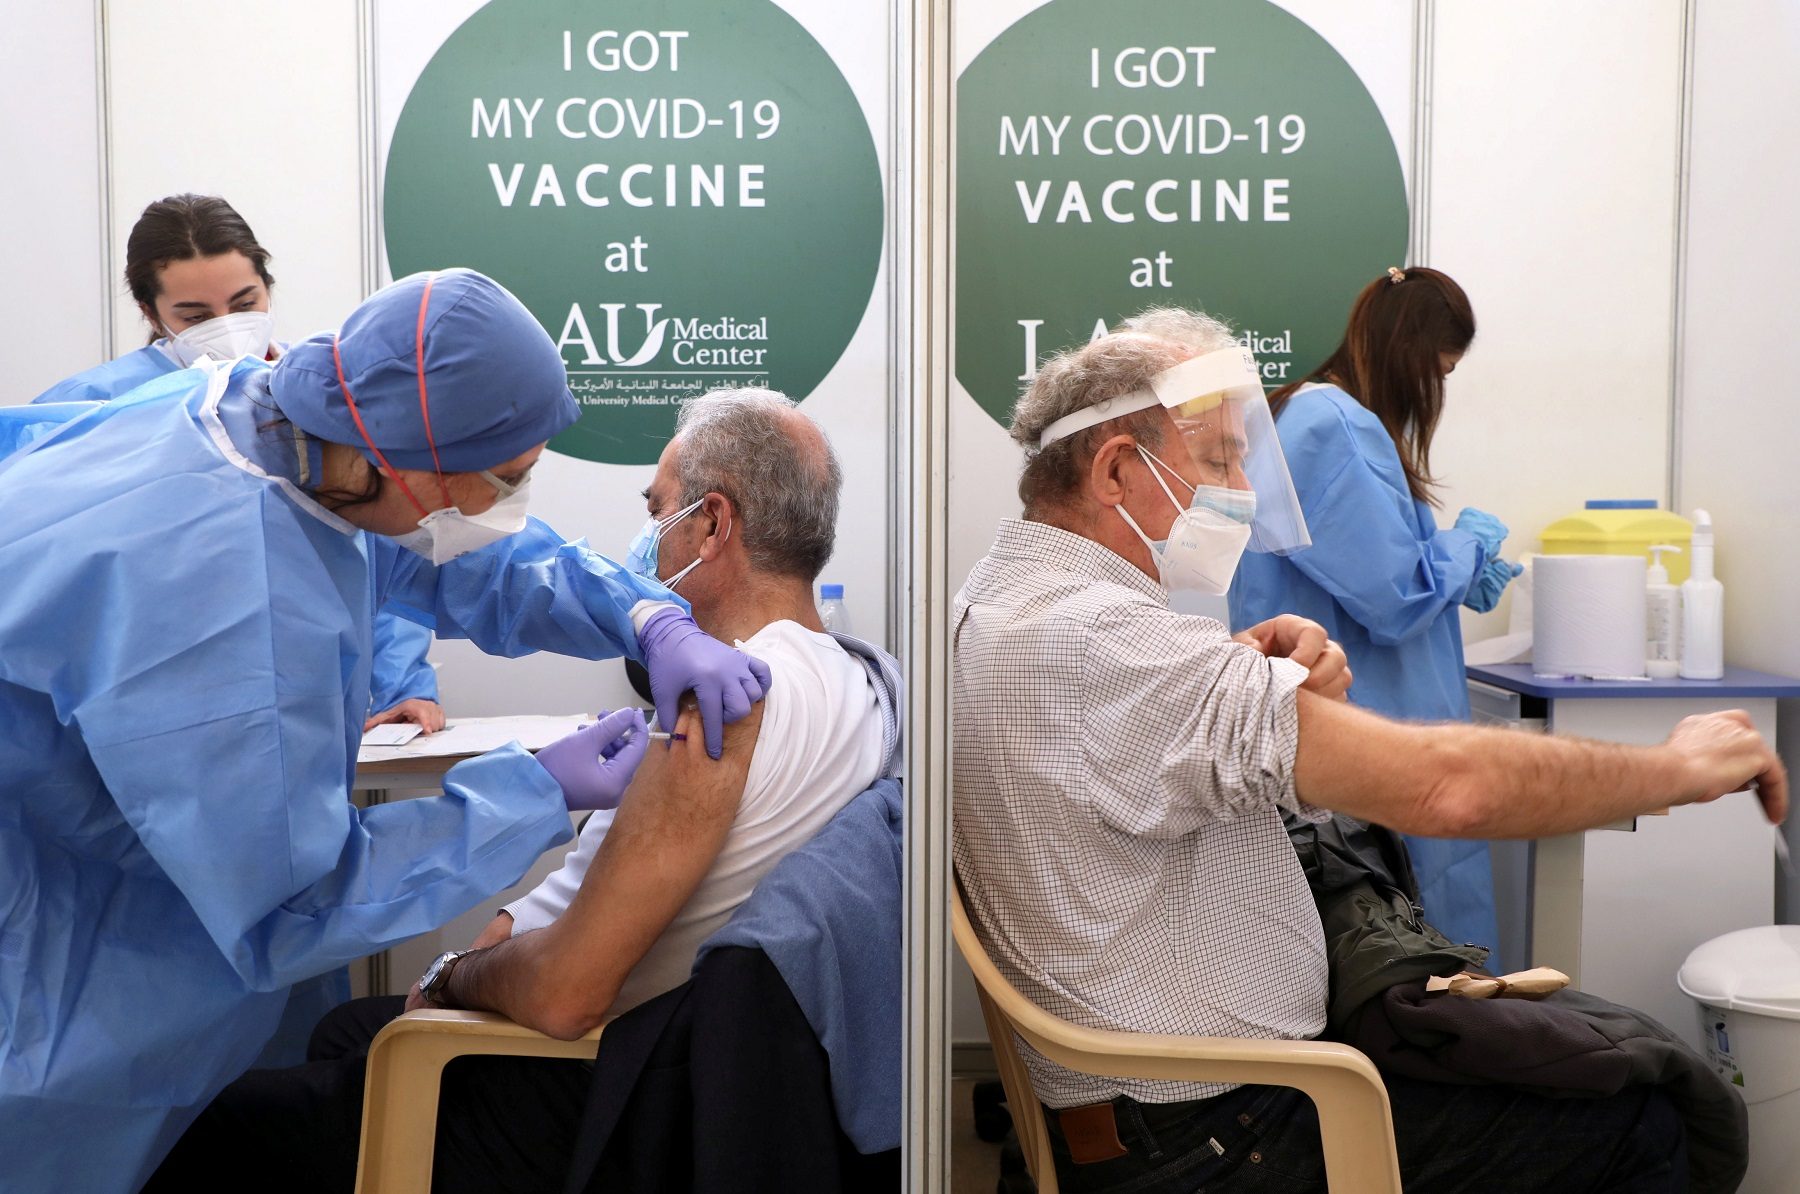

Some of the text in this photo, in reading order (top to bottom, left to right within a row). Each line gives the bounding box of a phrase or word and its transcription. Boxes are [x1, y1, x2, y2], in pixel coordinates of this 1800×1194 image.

[563, 30, 689, 72] I GOT
[1091, 46, 1216, 88] I GOT
[471, 98, 780, 140] MY COVID-19
[999, 114, 1306, 156] MY COVID-19
[487, 163, 766, 208] VACCINE
[1015, 178, 1291, 224] VACCINE
[604, 235, 649, 273] at
[1129, 250, 1173, 288] at
[557, 302, 670, 367] AU
[672, 316, 768, 340] Medical
[1238, 330, 1292, 354] dical
[672, 340, 768, 366] Center
[582, 395, 629, 409] University
[632, 394, 668, 405] Medical
